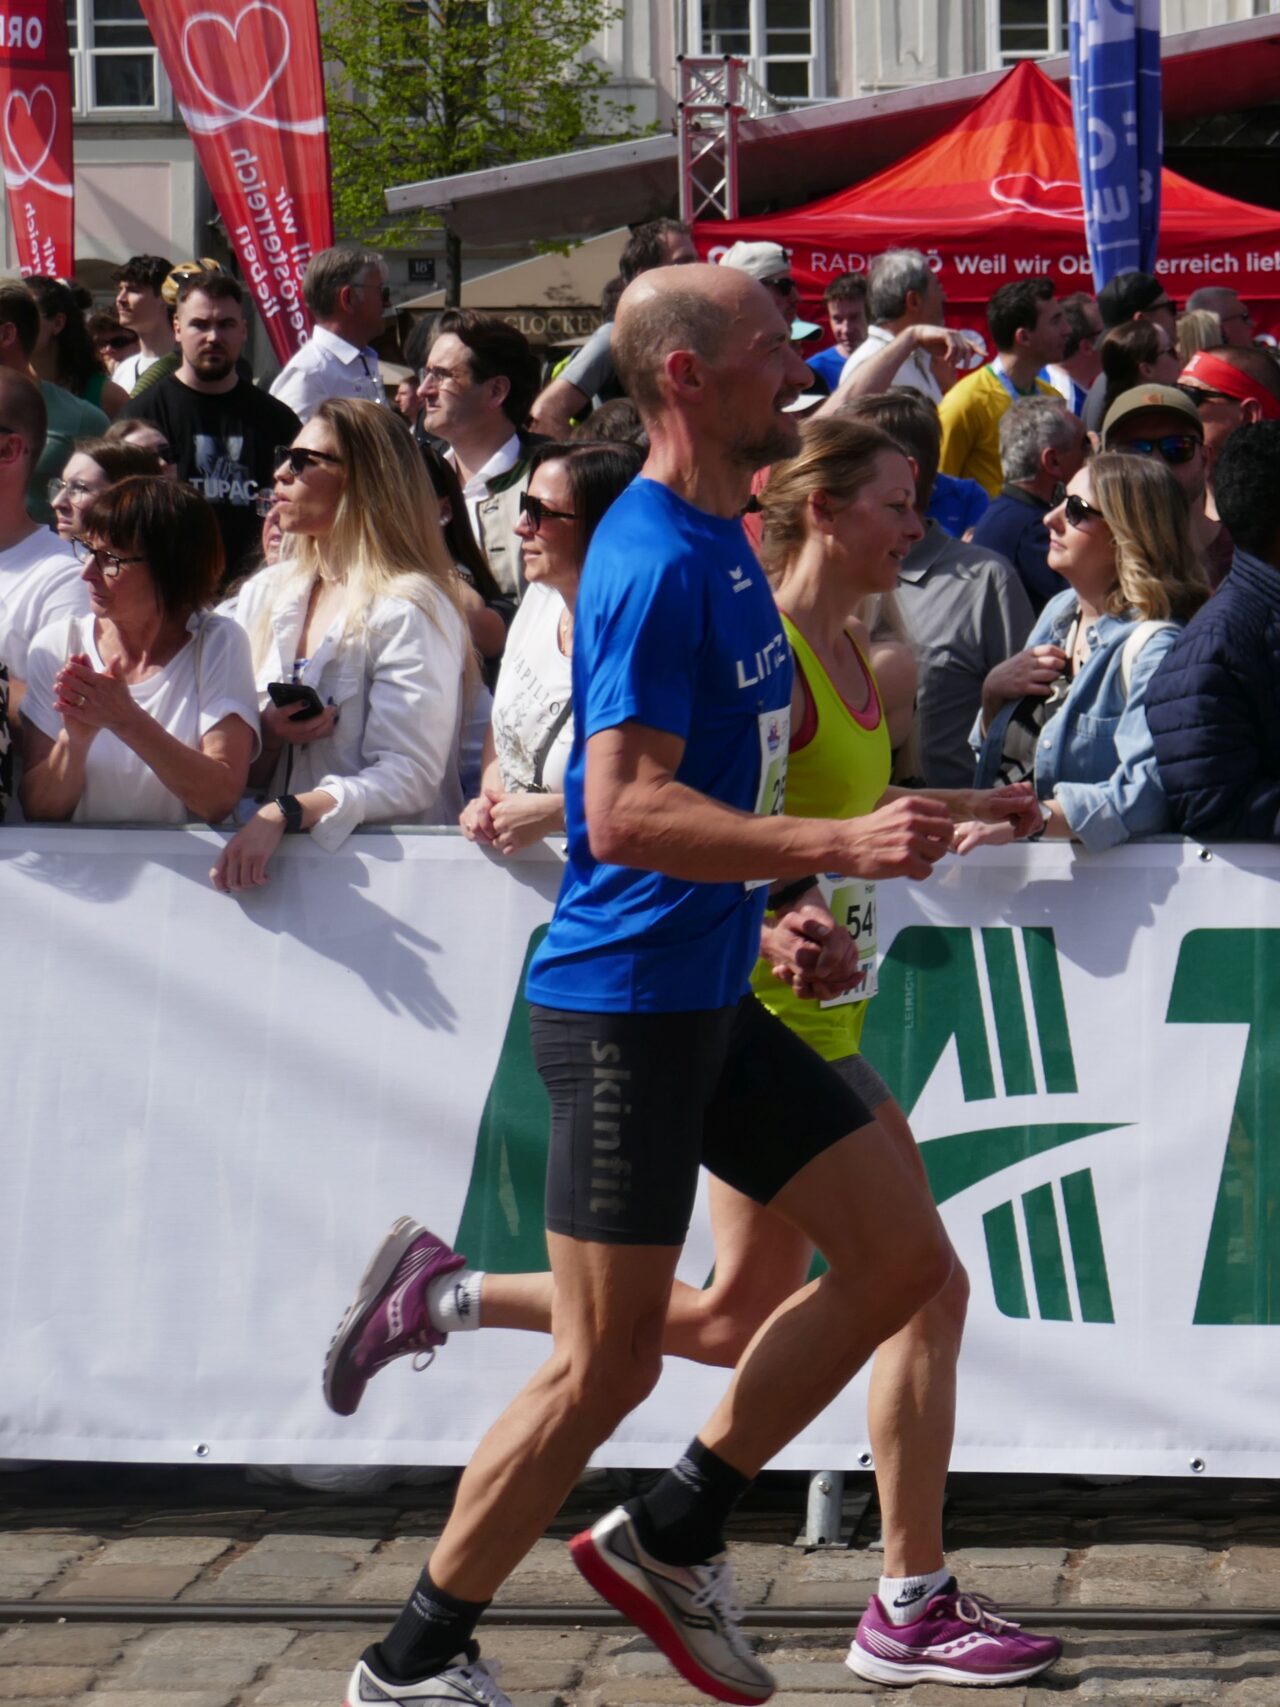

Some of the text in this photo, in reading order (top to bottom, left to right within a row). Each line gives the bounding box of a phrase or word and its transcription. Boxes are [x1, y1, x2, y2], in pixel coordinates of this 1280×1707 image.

[954, 254, 1007, 275] Weil
[1013, 253, 1050, 274] wir
[1058, 252, 1239, 275] Oberreich
[188, 478, 259, 500] TUPAC
[514, 652, 561, 717] APILLO
[846, 901, 877, 940] 54
[589, 1040, 632, 1214] skinfit
[900, 1584, 927, 1600] NIKE
